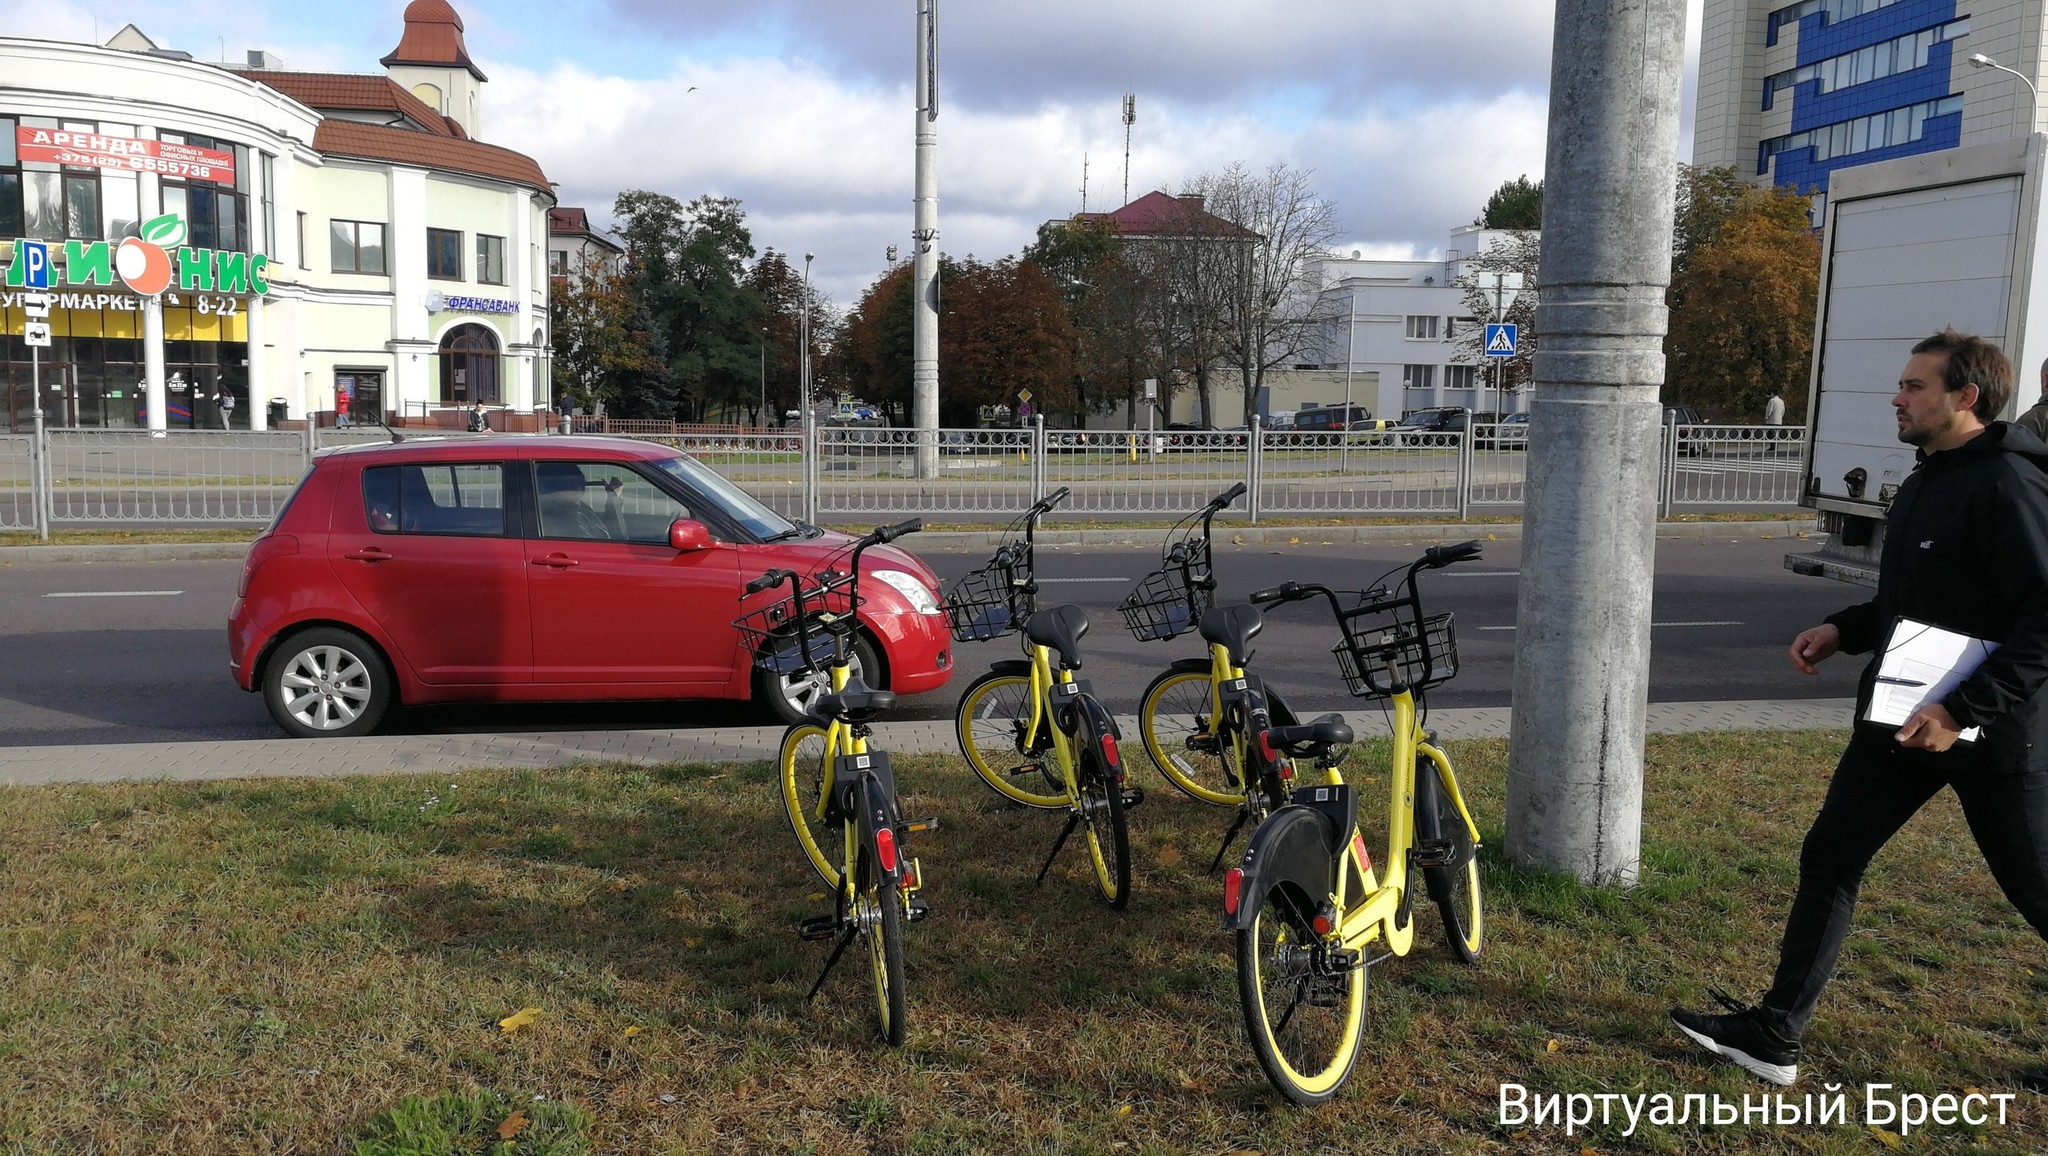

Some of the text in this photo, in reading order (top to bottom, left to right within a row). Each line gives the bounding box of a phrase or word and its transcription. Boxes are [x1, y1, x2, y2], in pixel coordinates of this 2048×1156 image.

[33, 130, 146, 155] АРЕНДА
[159, 143, 205, 157] ТОРГОВЫХ И
[53, 152, 90, 163] +375
[129, 157, 210, 179] 6555736
[160, 150, 197, 162] ОФИСНЫХ
[197, 294, 237, 316] 8-22
[448, 296, 520, 313] ФРАНСАБАНК
